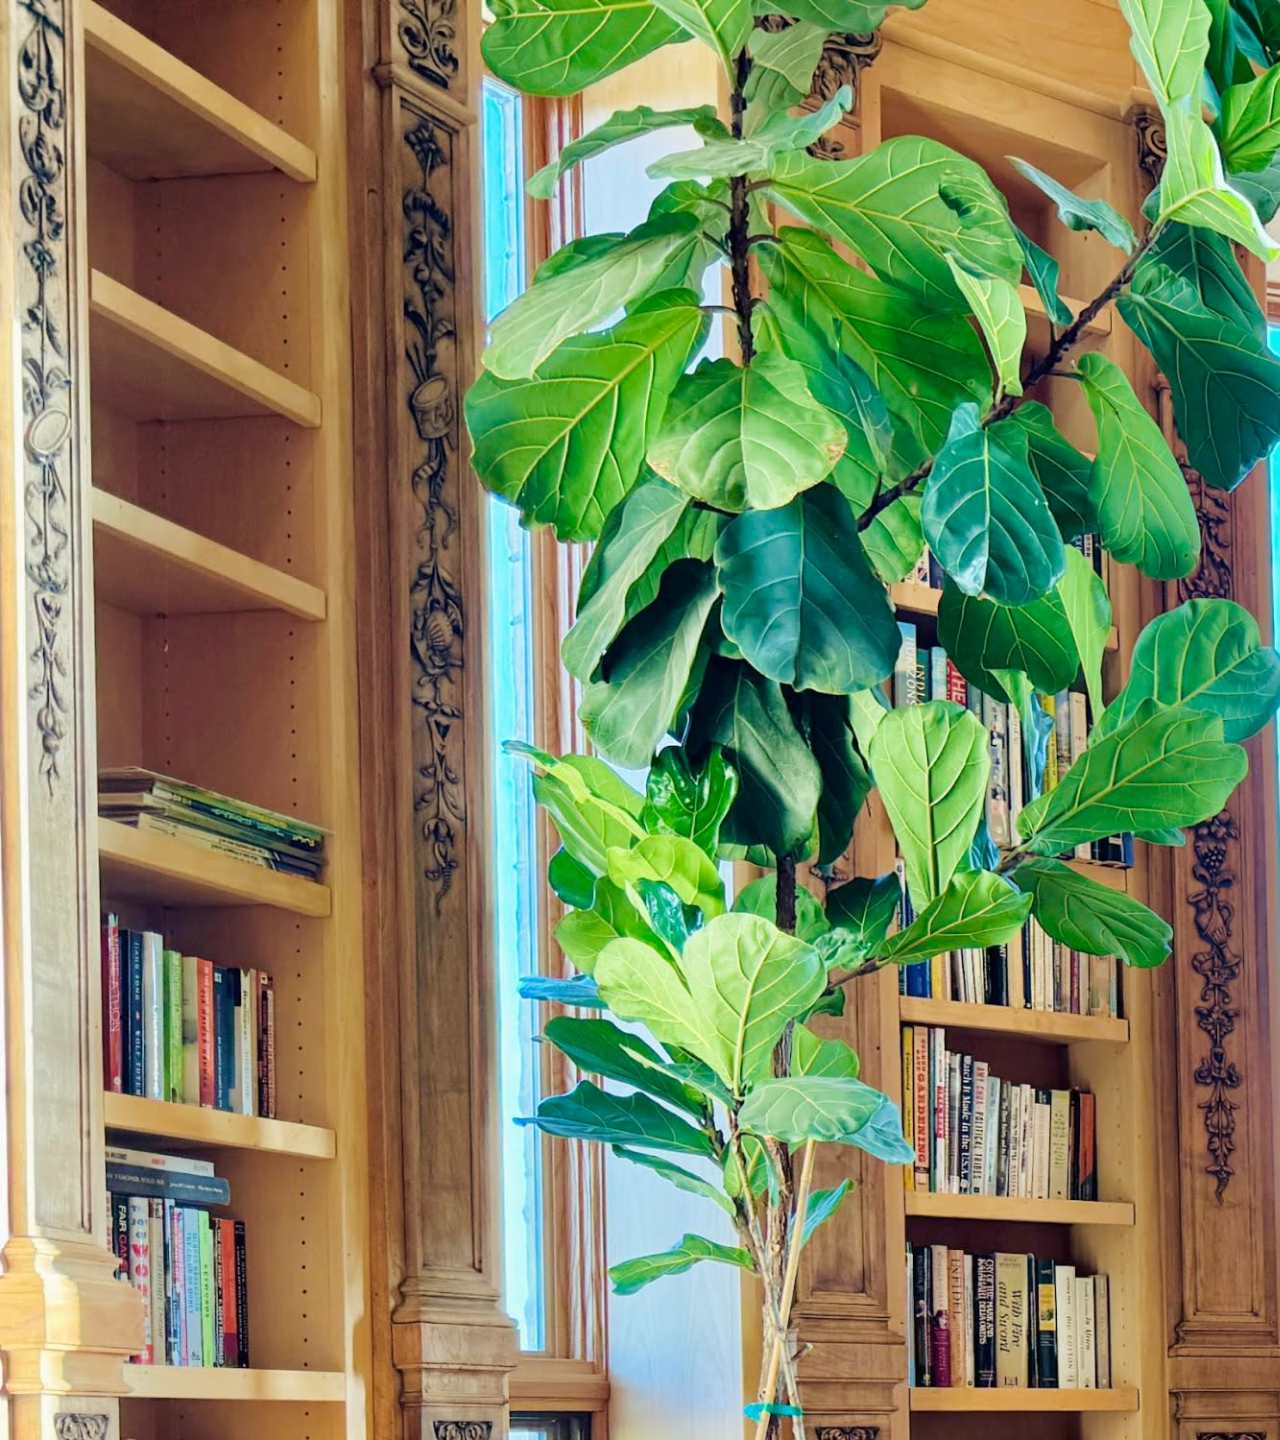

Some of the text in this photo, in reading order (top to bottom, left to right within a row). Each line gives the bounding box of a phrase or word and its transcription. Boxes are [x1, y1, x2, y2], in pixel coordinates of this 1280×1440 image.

[952, 671, 966, 702] THE
[962, 1055, 972, 1082] atch
[918, 1073, 926, 1162] GARDENING
[962, 1095, 972, 1119] Made
[962, 1134, 972, 1149] the
[974, 1112, 984, 1149] POLITICAL
[118, 1205, 127, 1231] FAIR
[986, 1259, 994, 1274] CRY
[986, 1321, 994, 1337] AND
[998, 1281, 1010, 1353] and Sword
[1012, 1290, 1023, 1346] With Fire
